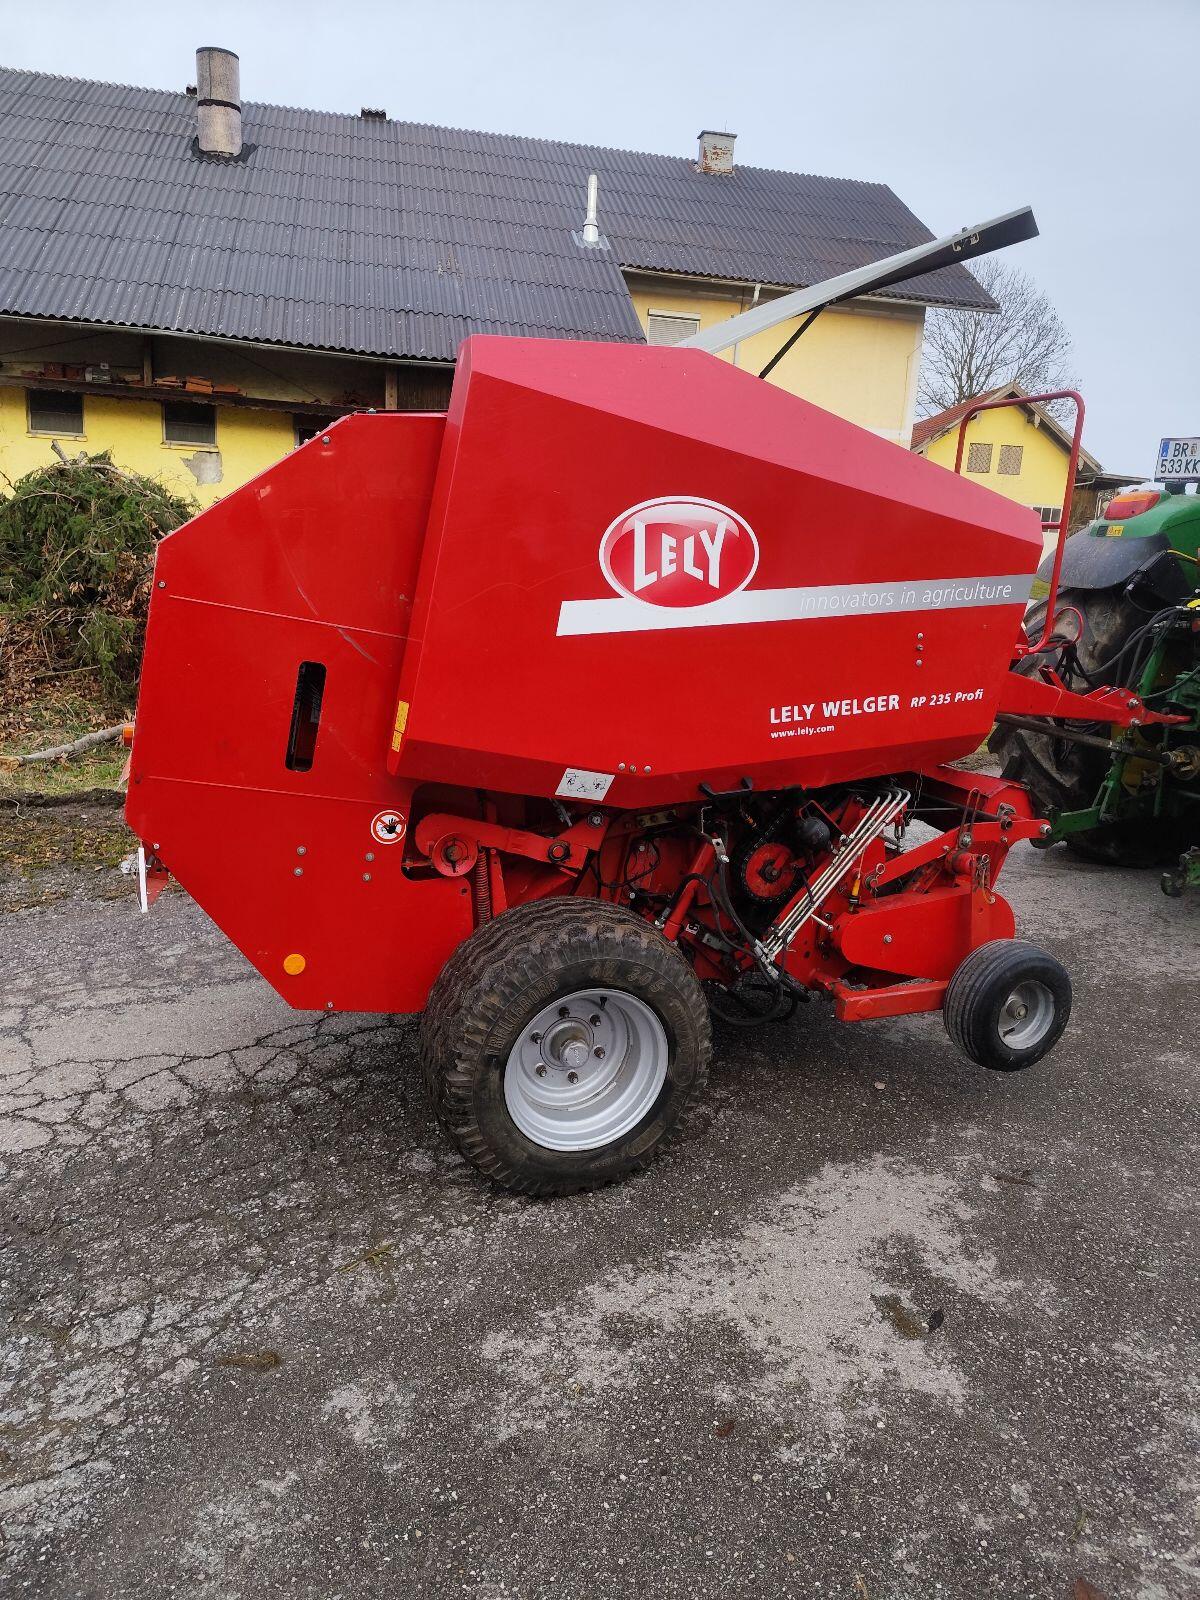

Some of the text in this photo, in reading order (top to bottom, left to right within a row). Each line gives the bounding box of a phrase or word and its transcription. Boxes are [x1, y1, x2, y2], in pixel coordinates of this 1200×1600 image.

[1173, 442, 1189, 457] BR
[1160, 459, 1200, 474] 533 KK
[633, 518, 728, 593] LELY
[800, 581, 1013, 612] innovators in agriculture
[769, 688, 984, 724] LELY WELGER RP 235 Profi
[770, 723, 835, 739] www.lely.com
